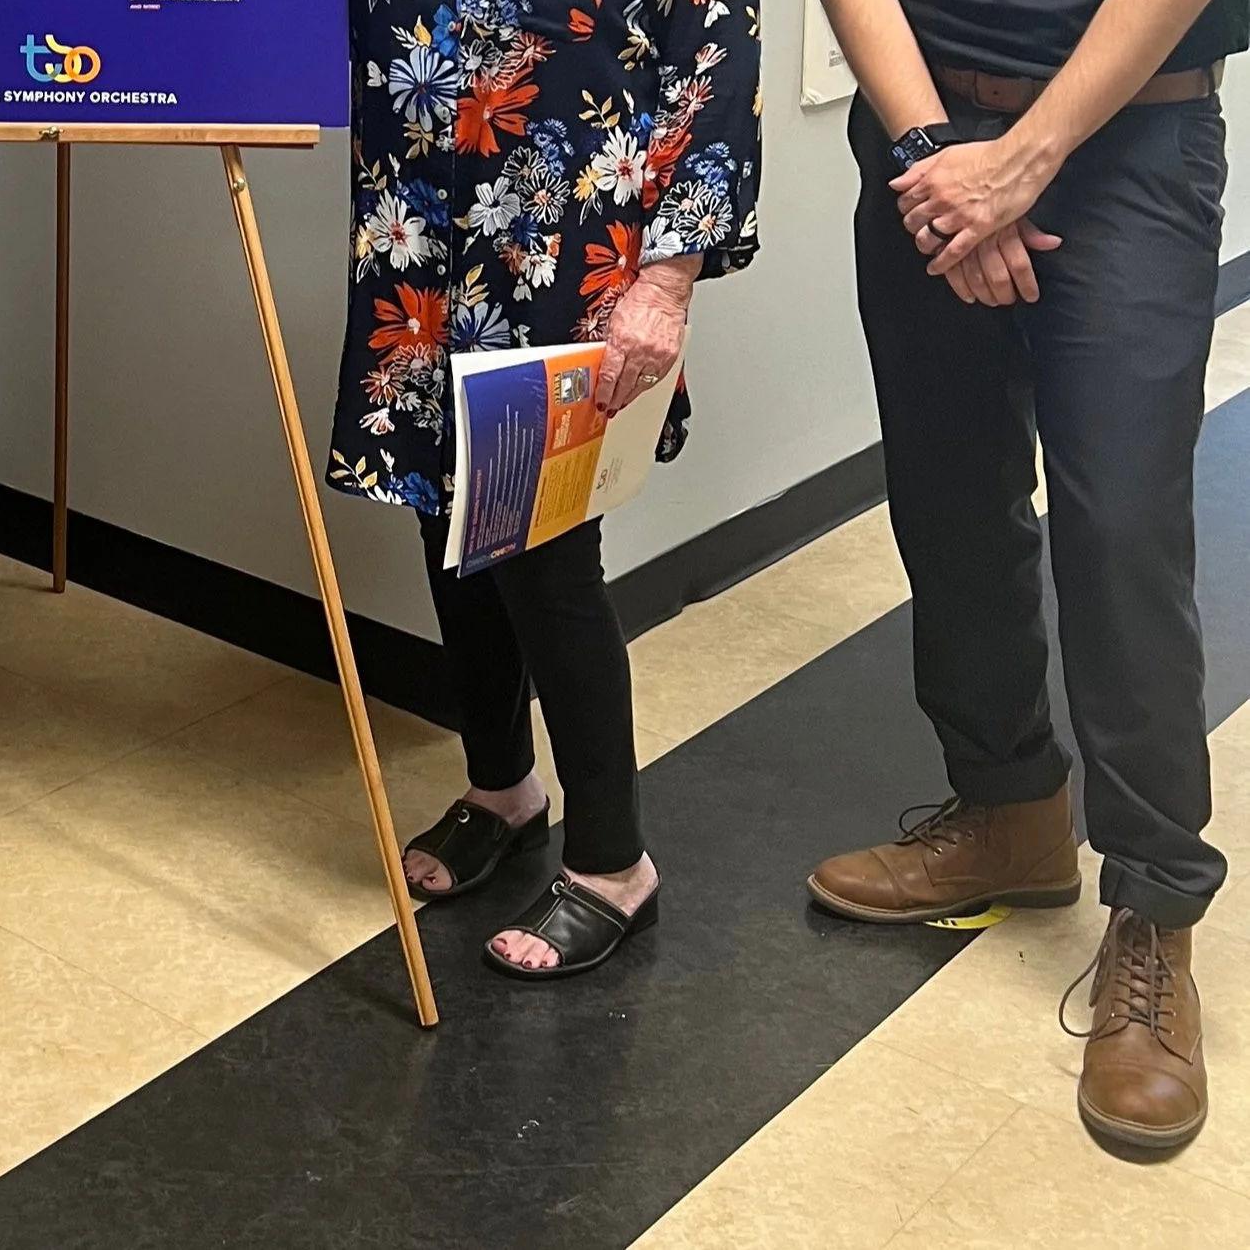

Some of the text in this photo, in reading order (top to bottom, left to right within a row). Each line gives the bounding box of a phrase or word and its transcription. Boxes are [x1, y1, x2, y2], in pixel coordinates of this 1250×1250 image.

[19, 34, 101, 83] tso
[3, 90, 86, 104] SYMPHONY
[89, 91, 178, 105] ORCHESTRA
